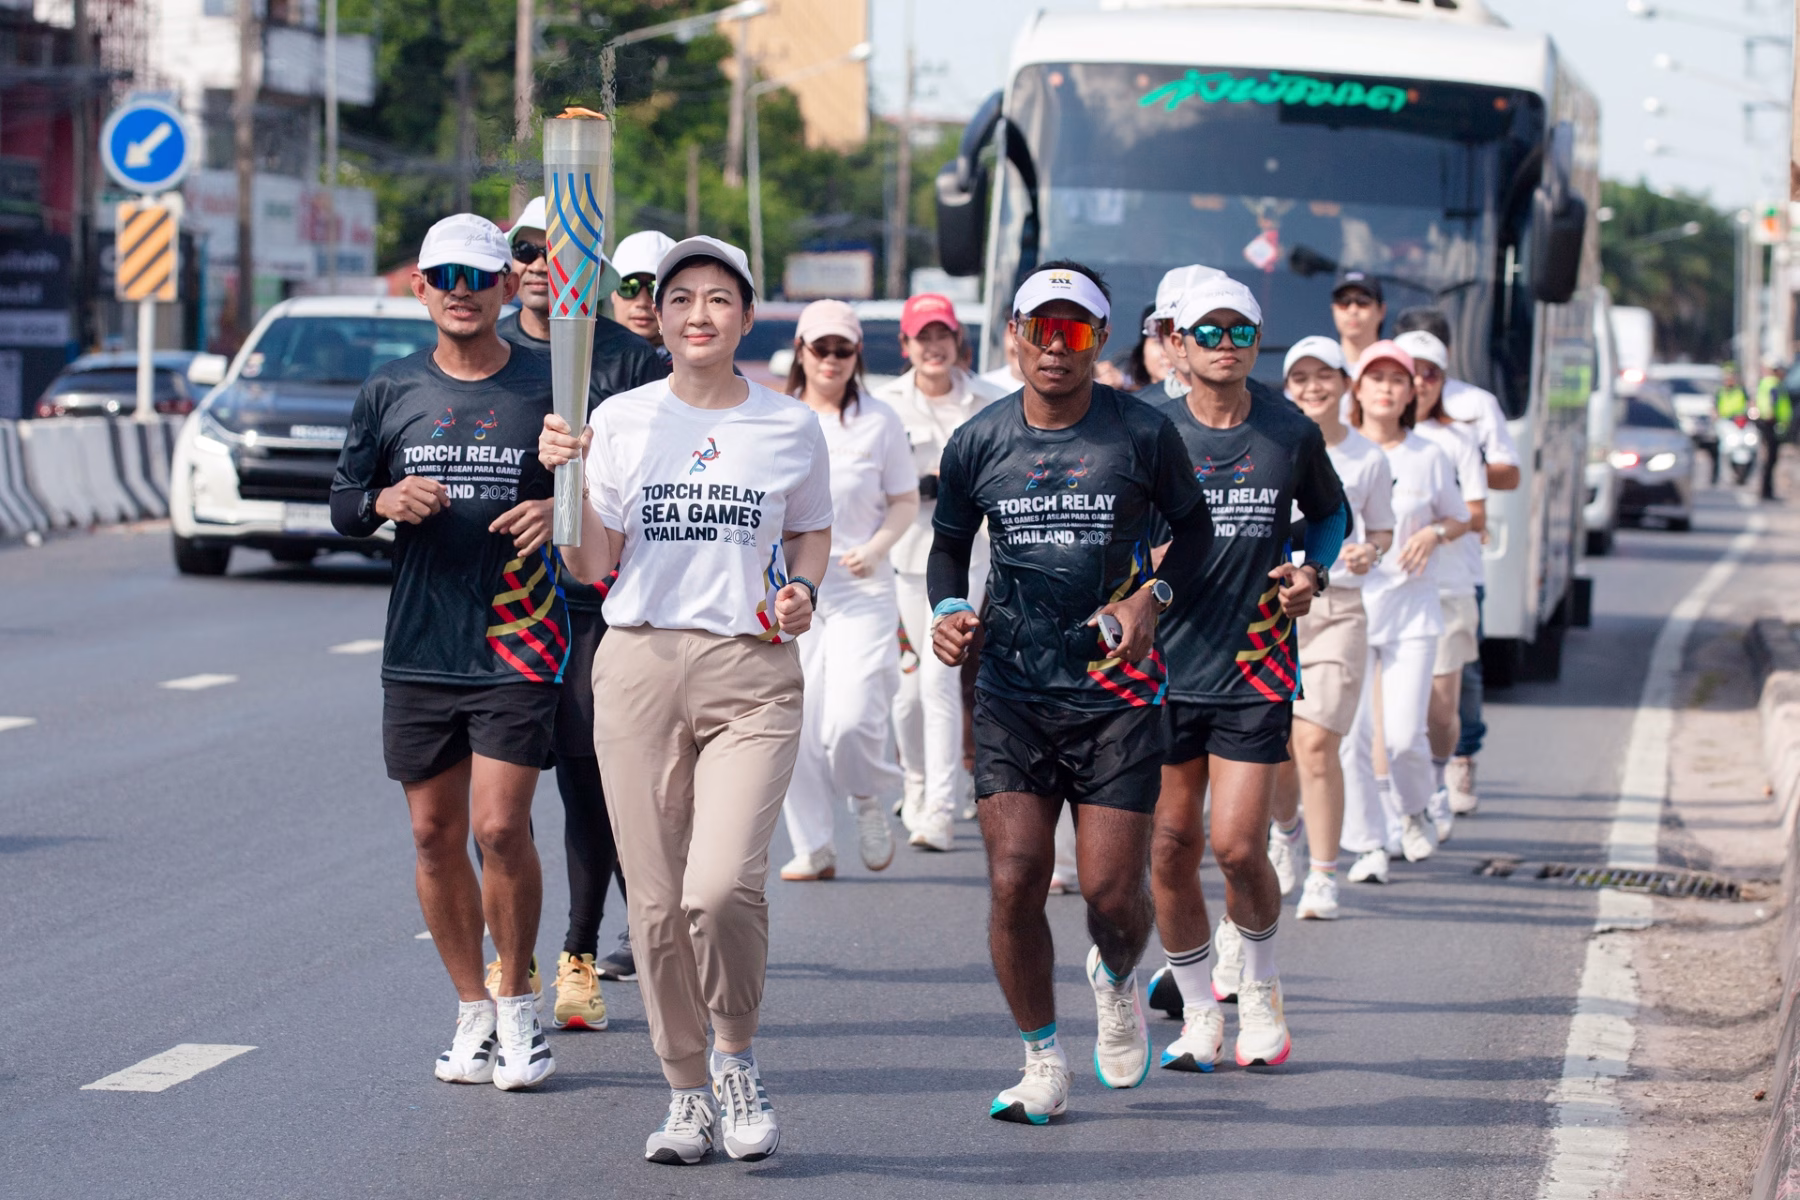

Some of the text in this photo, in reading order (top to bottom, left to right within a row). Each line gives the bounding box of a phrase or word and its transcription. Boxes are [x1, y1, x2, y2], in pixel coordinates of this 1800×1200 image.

[404, 445, 525, 465] TORCH RELAY
[417, 465, 441, 473] GAMES
[448, 465, 472, 473] ASEAN
[474, 465, 494, 473] PARA
[496, 467, 522, 476] GAMES
[642, 483, 766, 506] TORCH RELAY
[1228, 488, 1279, 504] RELAY
[997, 494, 1117, 515] TORCH RELAY
[642, 503, 762, 529] SEA GAMES
[1014, 514, 1040, 523] GAMES
[1047, 513, 1070, 521] ASEAN
[1071, 513, 1089, 521] PARA
[1091, 513, 1115, 521] GAMES
[644, 526, 718, 541] THAILAND
[1008, 530, 1075, 545] THAILAND
